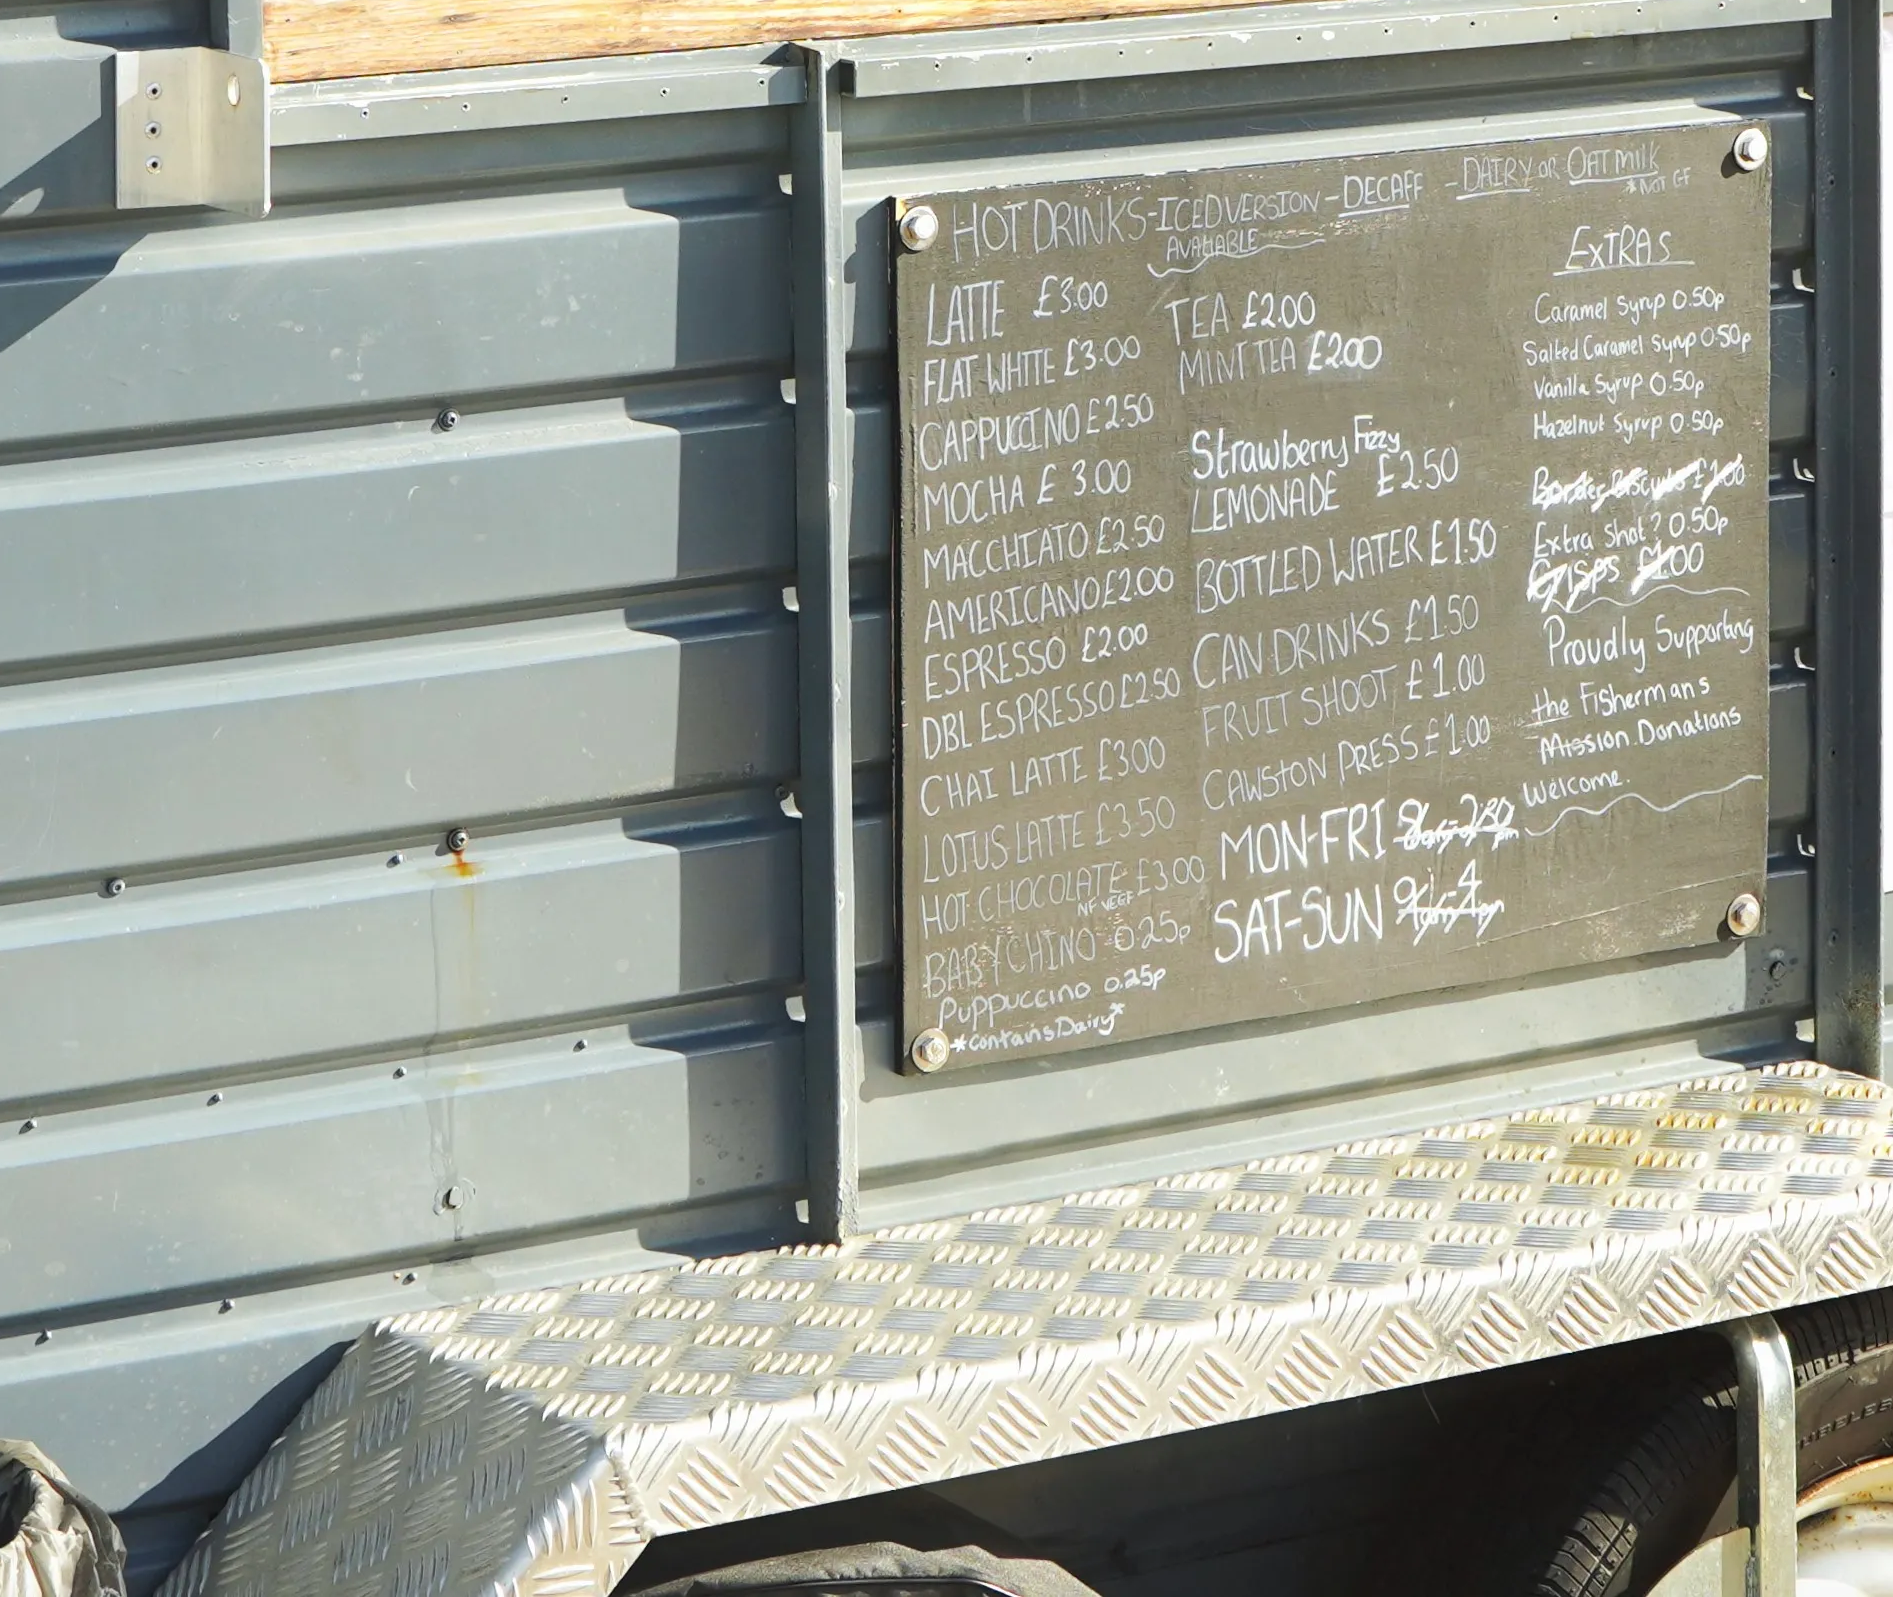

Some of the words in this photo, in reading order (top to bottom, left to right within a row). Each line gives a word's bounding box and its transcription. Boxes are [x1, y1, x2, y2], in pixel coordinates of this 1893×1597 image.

[953, 199, 1029, 263] HOT
[926, 279, 1006, 347] LATTE
[1033, 274, 1108, 318] £3.00
[1164, 292, 1230, 346] TEA
[1241, 289, 1316, 331] £2.00
[1534, 292, 1608, 325] Caramel
[1616, 291, 1666, 326] Syrup
[1671, 285, 1726, 315] 0.50p
[923, 354, 979, 407] FLAT
[986, 347, 1056, 395] WHITE
[1063, 334, 1141, 377] £3.00
[1534, 371, 1590, 401] Vanilla
[1594, 371, 1645, 405] Syrup
[1649, 369, 1706, 401] 0.50p
[919, 402, 1081, 472] CAPPUCCINO
[1086, 391, 1155, 434] £2.50
[1195, 544, 1323, 615] BOTTLED
[1331, 525, 1423, 587] WATER
[1429, 517, 1498, 568] £1.50
[924, 636, 1066, 703] ESPRESSO
[1081, 622, 1149, 663] £2.00
[1192, 631, 1264, 691] CAN
[1272, 607, 1391, 678] DRINKS
[1404, 593, 1480, 644] £1.50
[1542, 613, 1646, 674] Proudly
[1654, 608, 1755, 654] Supporting
[1201, 690, 1295, 749] FRUIT
[1302, 663, 1398, 728] SHOOT
[1406, 651, 1486, 701] £1.00
[1638, 705, 1743, 748] Donations
[920, 766, 999, 819] CHAI
[1009, 745, 1088, 798] LATTE
[1220, 797, 1388, 881] MON-FRI
[1213, 884, 1385, 964] SAT-SUN
